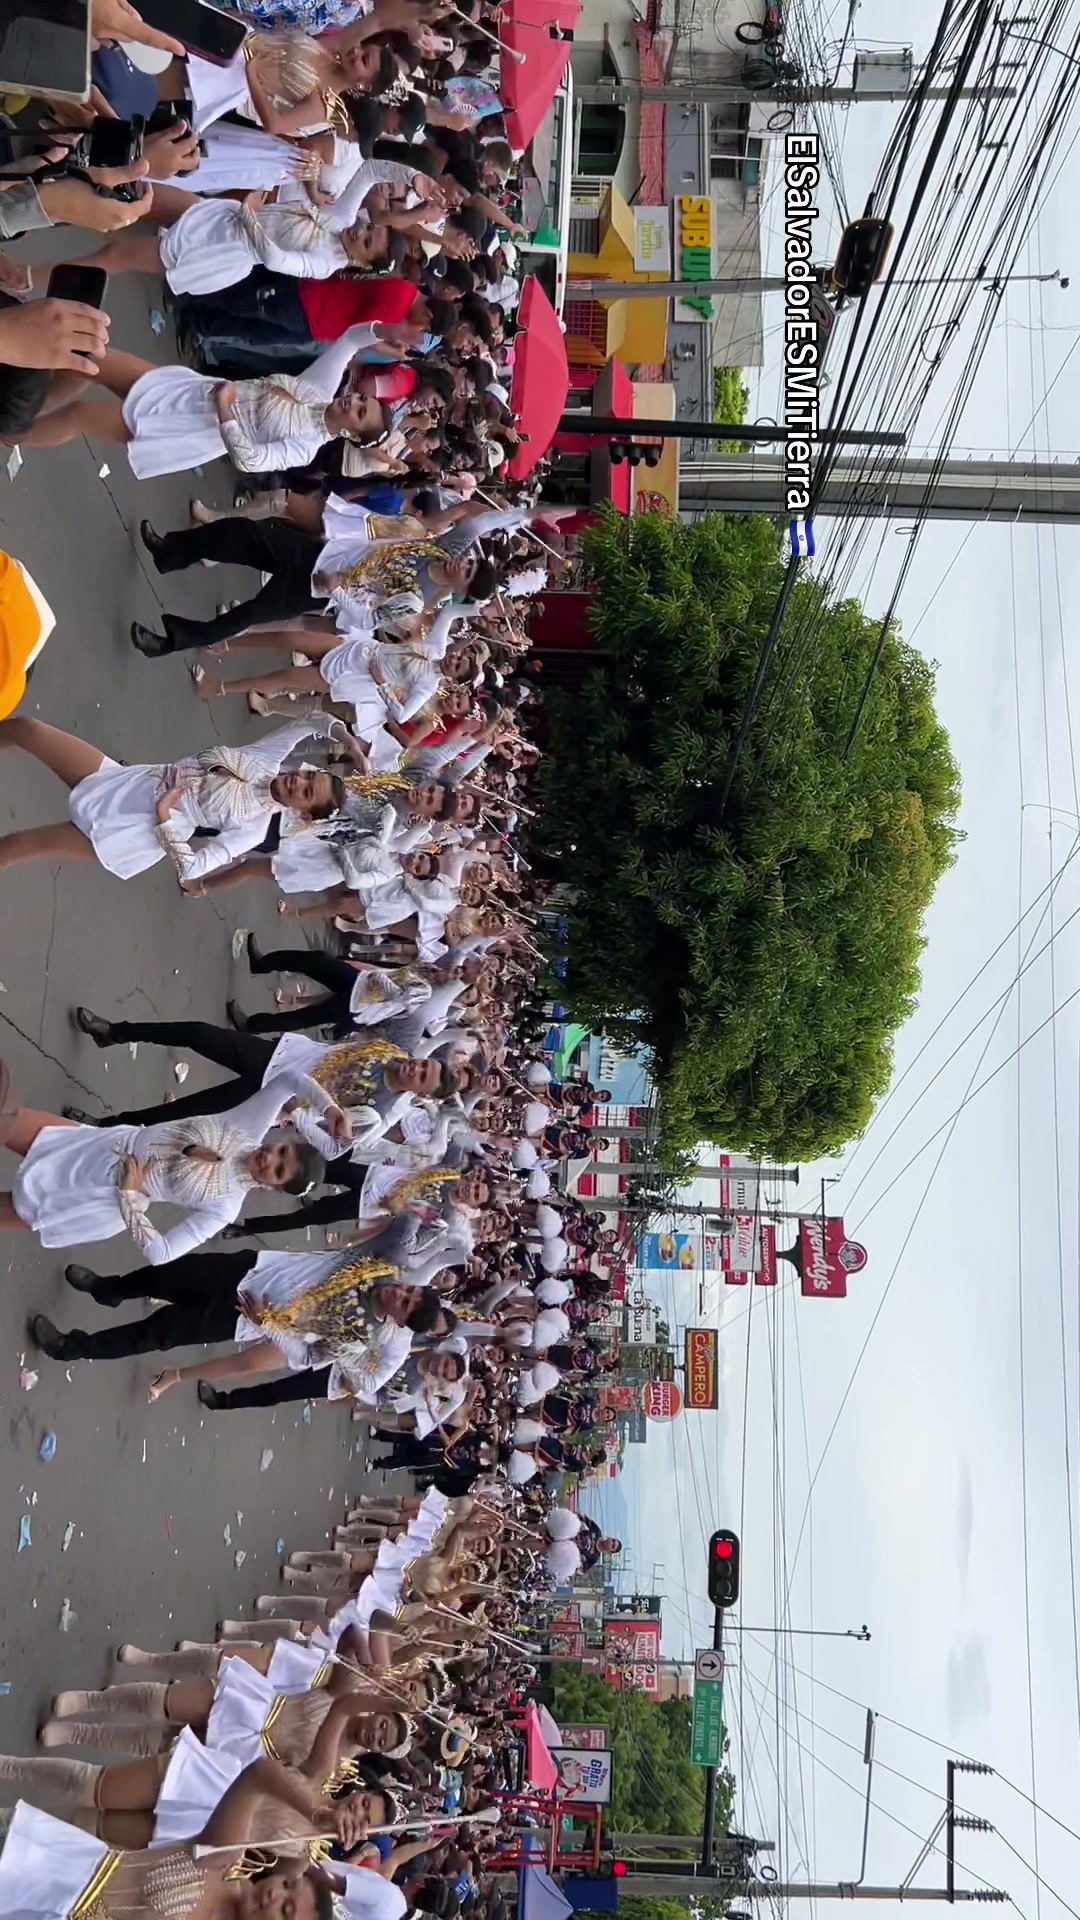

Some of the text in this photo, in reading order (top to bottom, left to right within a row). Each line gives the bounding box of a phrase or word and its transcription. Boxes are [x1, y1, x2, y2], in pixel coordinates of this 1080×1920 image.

[761, 1226, 770, 1282] AUTOSERVICIO
[804, 1220, 836, 1290] Wendy's
[634, 1291, 644, 1305] La
[644, 1299, 652, 1331] famacia
[693, 1333, 707, 1403] CAMPERO
[650, 1382, 661, 1416] KING
[661, 1382, 670, 1417] BURGER
[635, 1633, 646, 1687] ILIMITDOS
[589, 1759, 603, 1788] GRATIS
